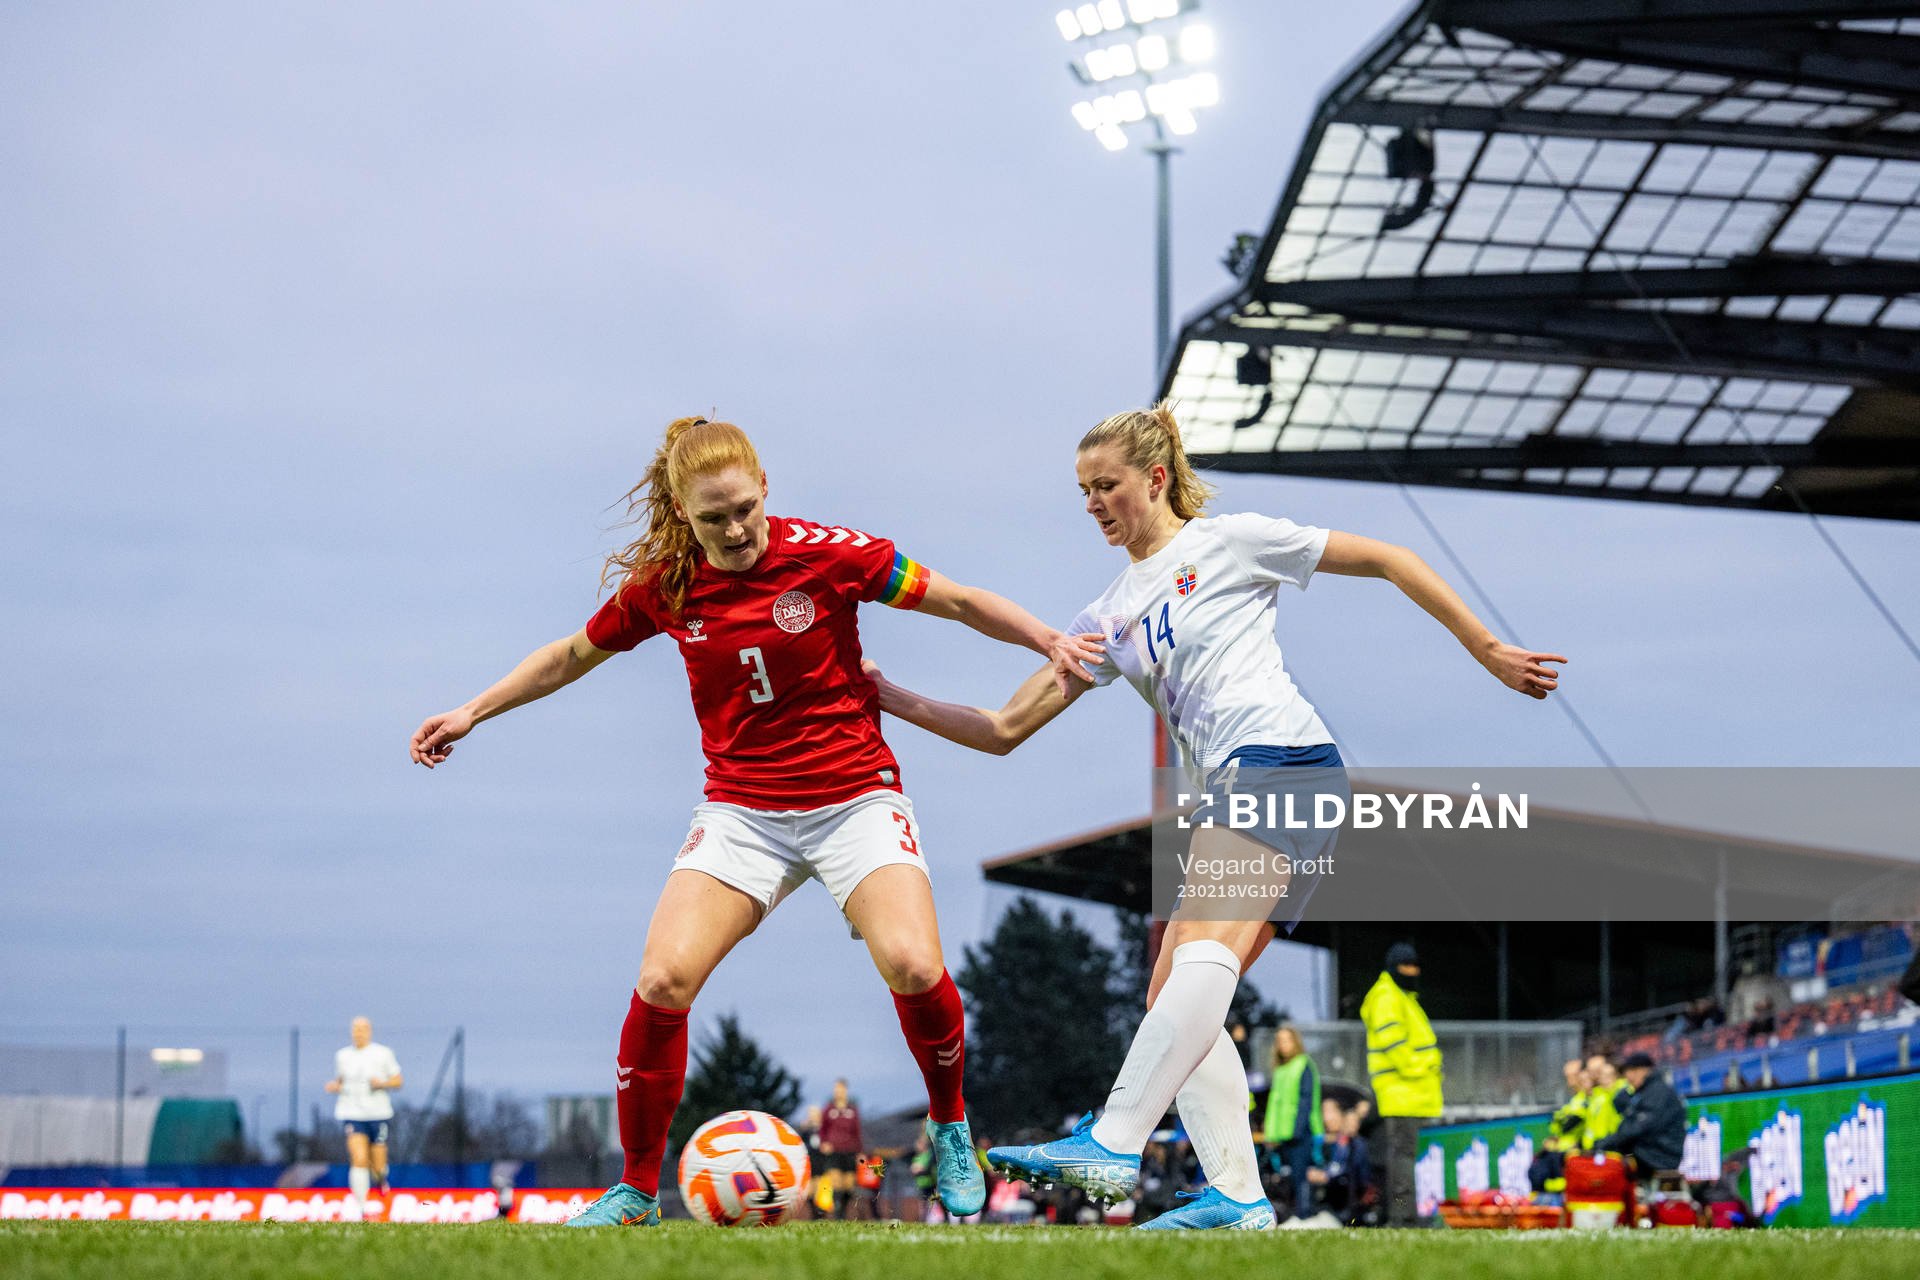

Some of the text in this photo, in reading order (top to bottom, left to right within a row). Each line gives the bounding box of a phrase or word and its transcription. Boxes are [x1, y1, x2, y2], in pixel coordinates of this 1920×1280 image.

[782, 604, 806, 619] DBU
[1142, 601, 1176, 664] 14
[739, 647, 774, 703] 3
[892, 811, 918, 856] 3
